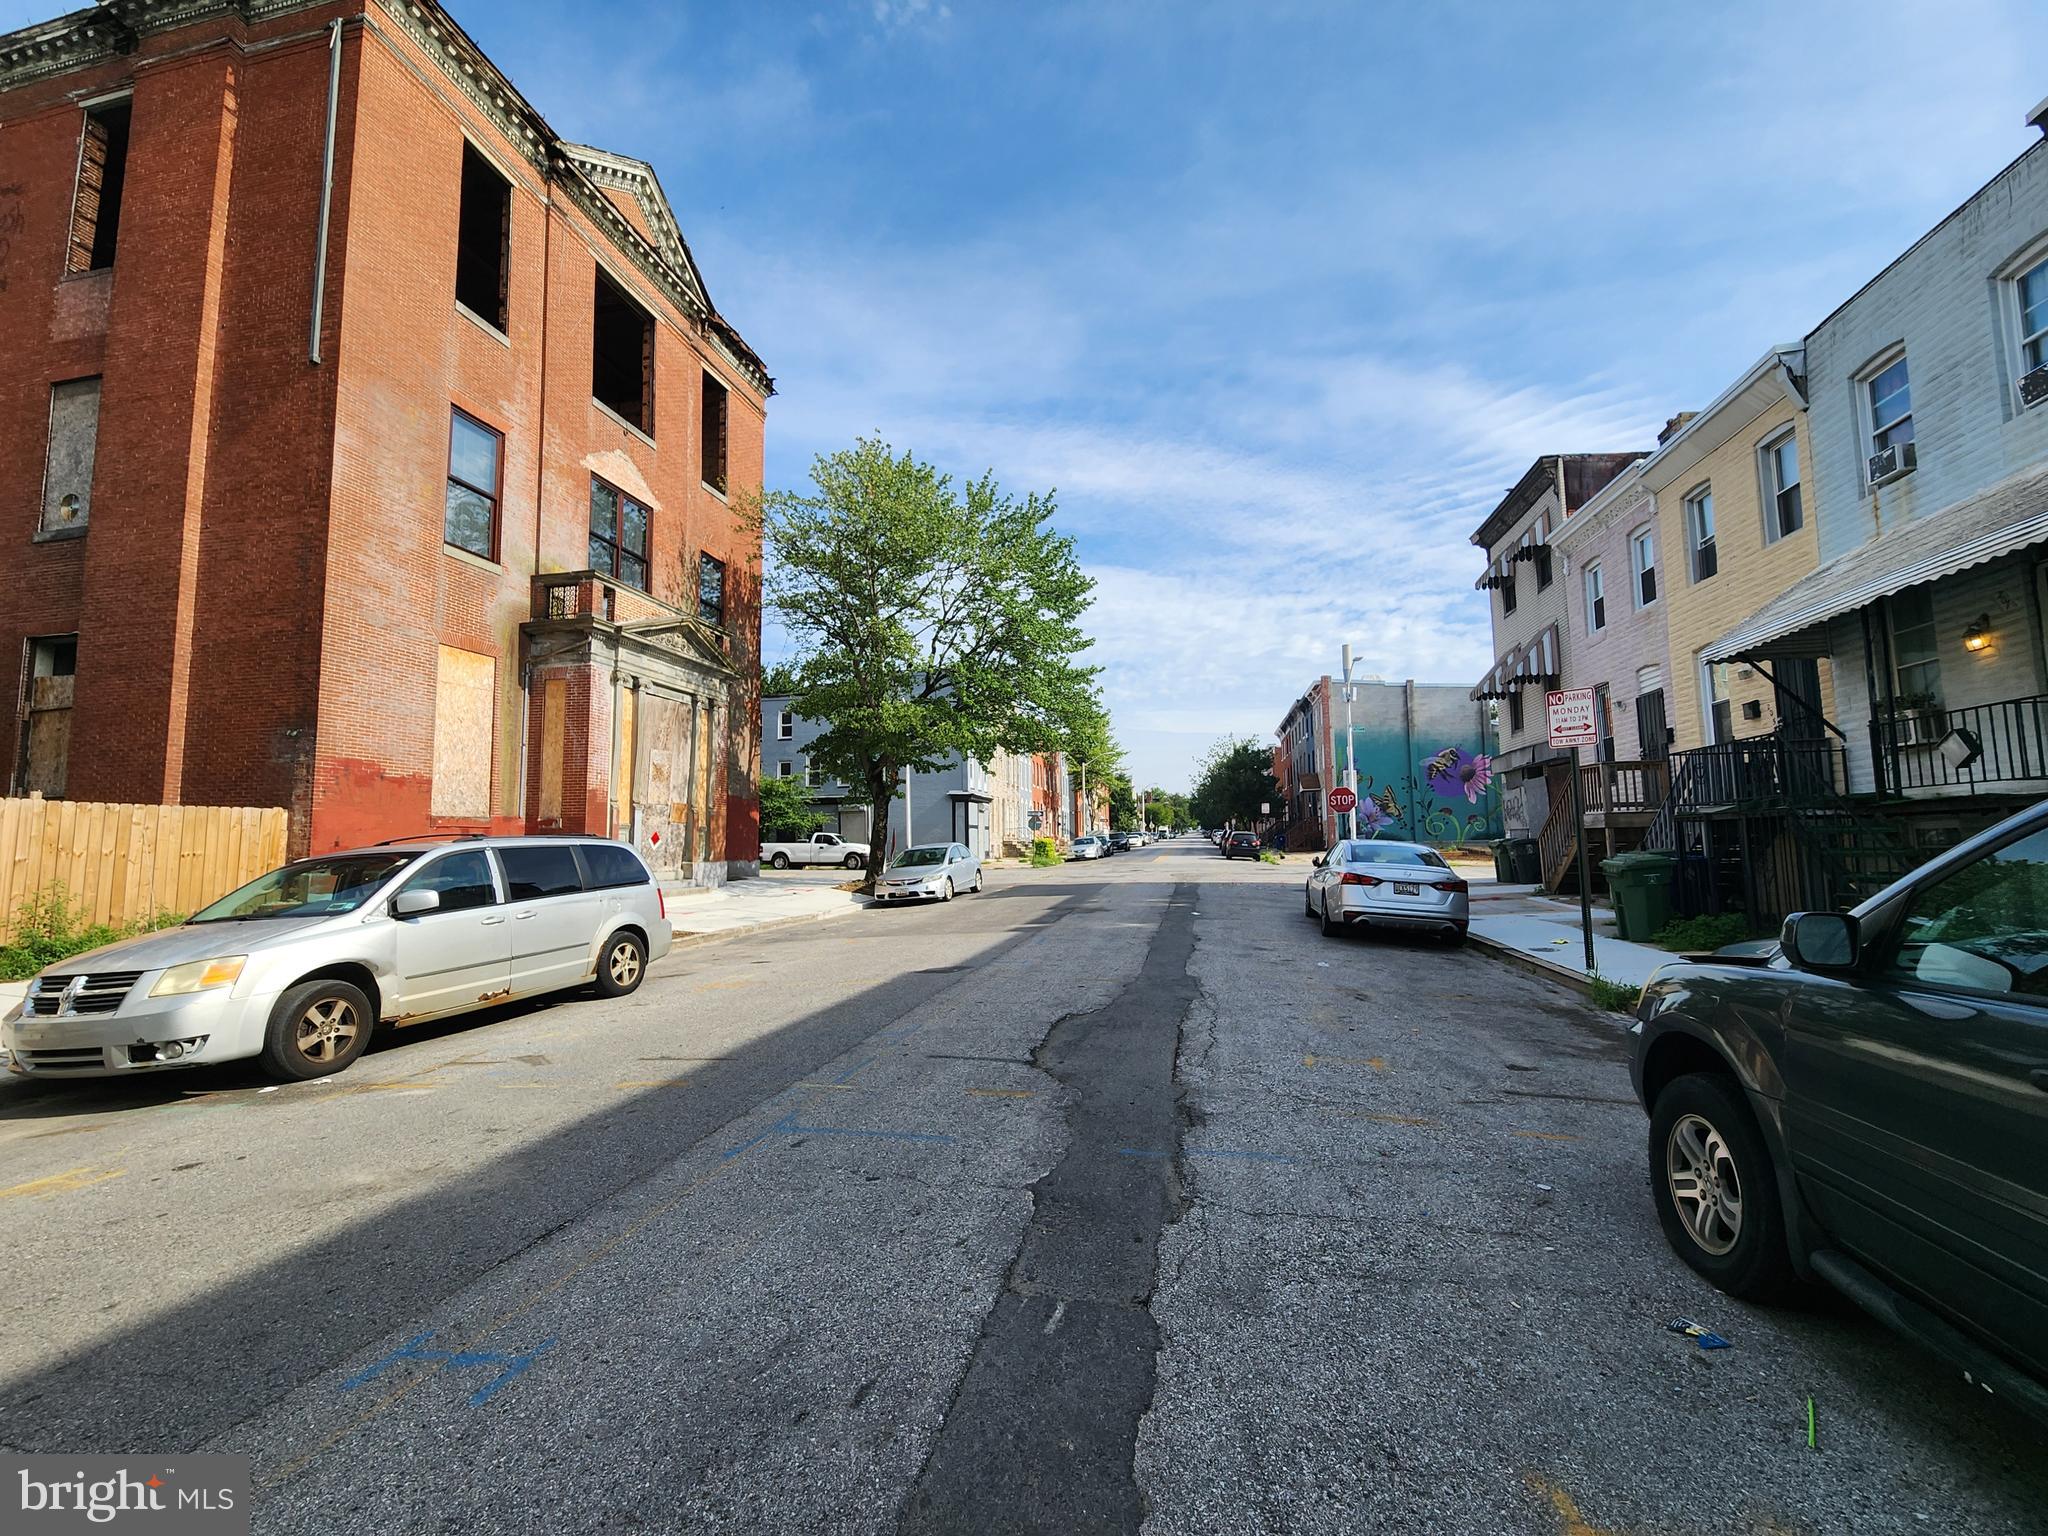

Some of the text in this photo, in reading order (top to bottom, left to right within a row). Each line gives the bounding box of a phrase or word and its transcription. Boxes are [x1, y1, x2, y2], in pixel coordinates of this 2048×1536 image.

[1548, 691, 1591, 706] NO PARKING
[1552, 705, 1590, 715] MONDAY
[1330, 794, 1354, 805] STOP
